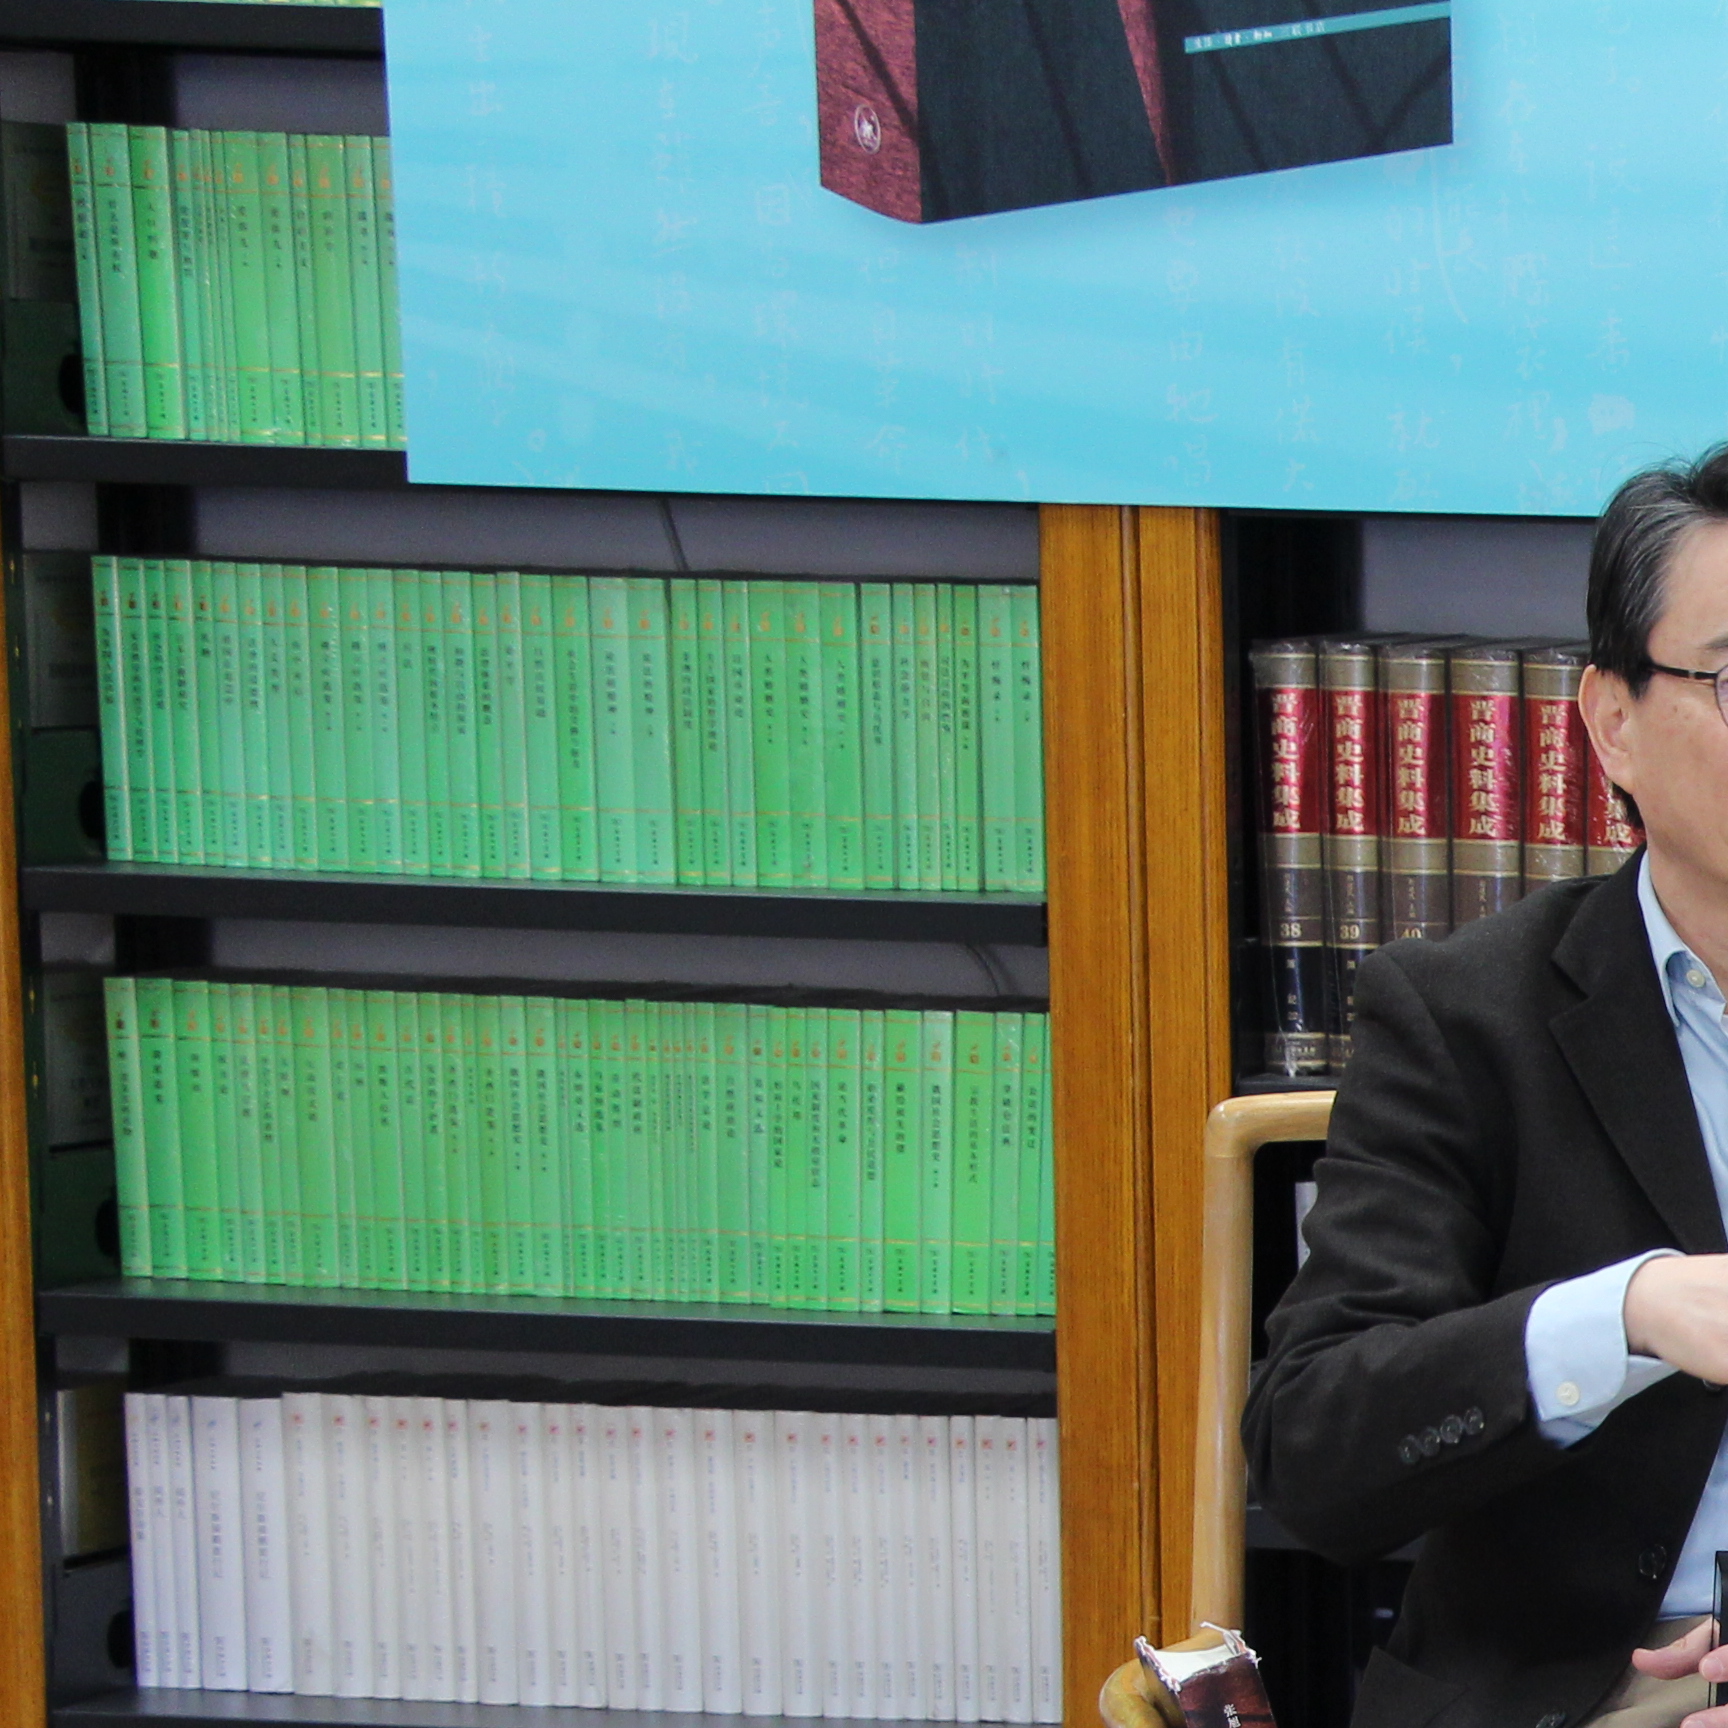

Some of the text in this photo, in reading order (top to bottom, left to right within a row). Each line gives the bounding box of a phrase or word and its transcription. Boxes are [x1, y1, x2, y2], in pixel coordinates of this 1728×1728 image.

[1271, 692, 1301, 830] 晋商史料集成
[1335, 690, 1365, 833] 晋商史料集成
[1398, 697, 1428, 837] 晋商史料集成
[1469, 699, 1499, 837] 晋商史料集成
[1538, 703, 1568, 841] 晋商史料集成
[1280, 923, 1303, 939] 38
[1339, 924, 1361, 940] 39
